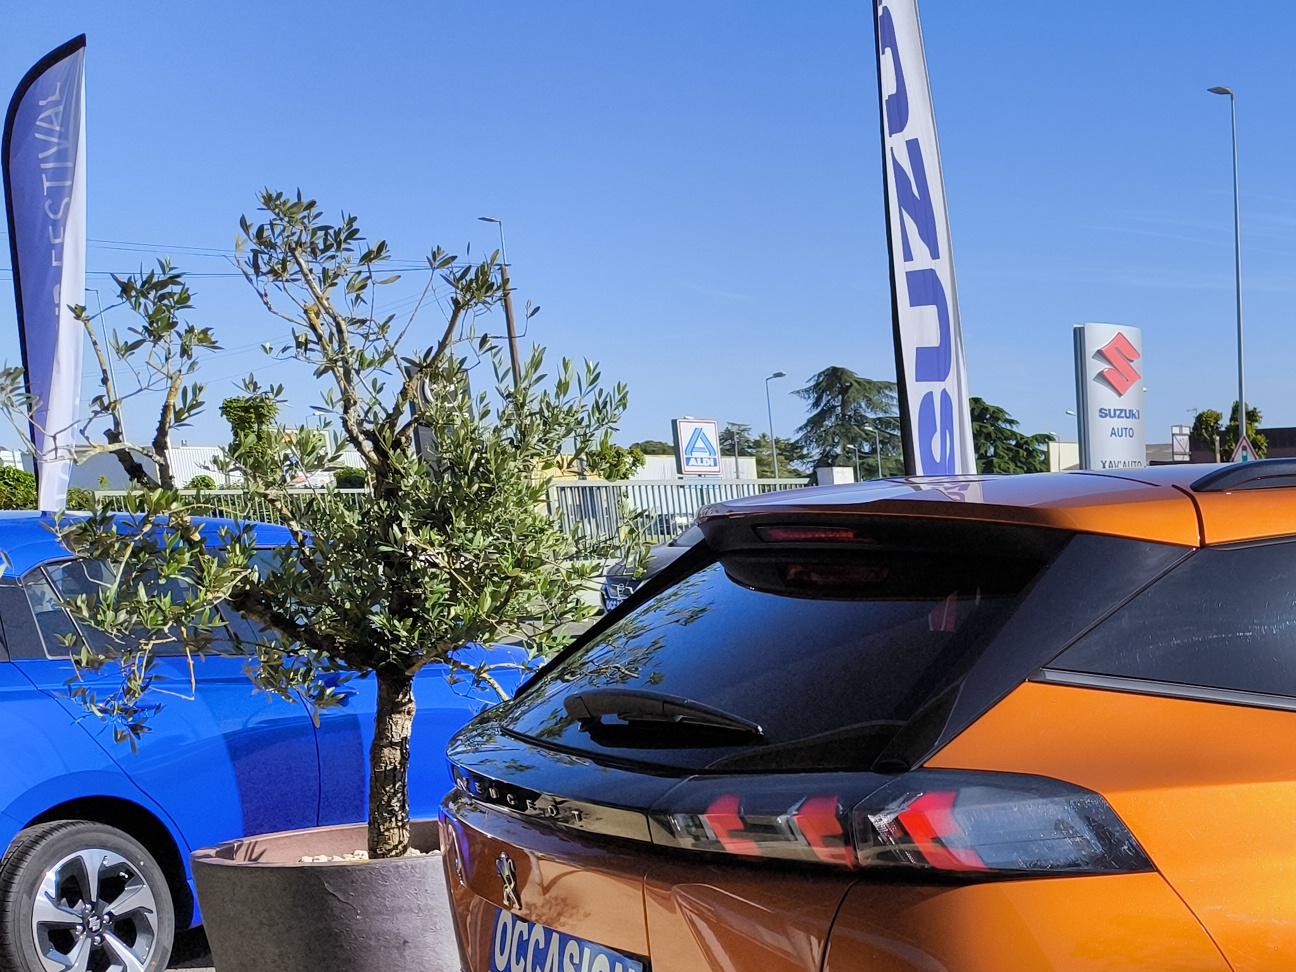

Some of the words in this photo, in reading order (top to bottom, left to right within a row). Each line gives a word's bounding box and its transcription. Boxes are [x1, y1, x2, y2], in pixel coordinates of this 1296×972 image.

[879, 0, 955, 476] SUZU
[1098, 407, 1140, 420] SUZUKI
[1110, 427, 1134, 438] AUTO
